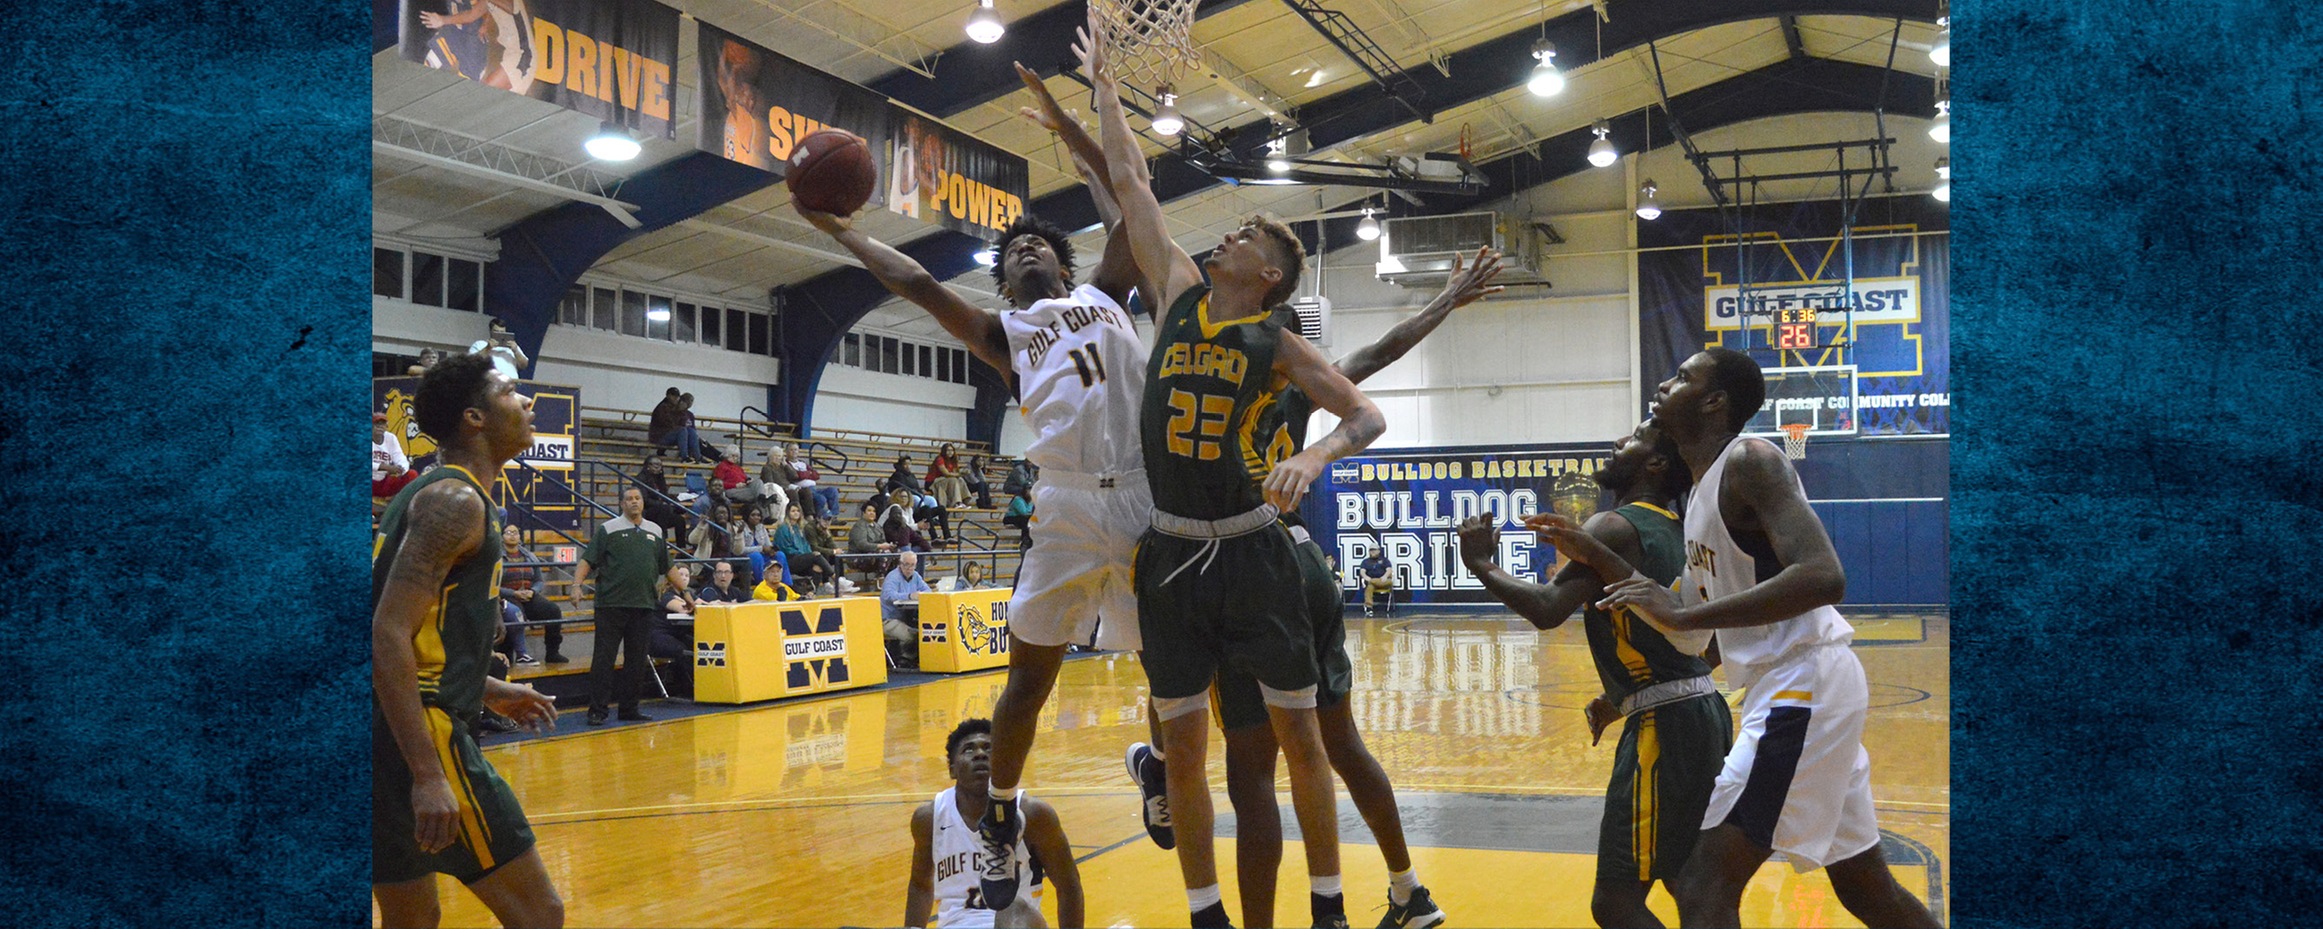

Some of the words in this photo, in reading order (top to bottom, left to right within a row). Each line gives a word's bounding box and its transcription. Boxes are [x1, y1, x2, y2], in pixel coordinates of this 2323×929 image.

[533, 16, 670, 121] DRIVE
[930, 169, 1024, 231] POWER
[1781, 309, 1816, 323] 6:36
[1027, 320, 1061, 367] GULF
[1061, 305, 1124, 334] COAST
[1780, 323, 1811, 348] 26
[1068, 341, 1107, 388] 11
[1158, 342, 1249, 391] DELGAD
[1827, 394, 1917, 409] COMUNITY
[1166, 387, 1236, 461] 23
[520, 442, 569, 459] OAST
[1361, 461, 1463, 481] BULLDOG
[1471, 458, 1606, 479] BASKETBAL
[1336, 488, 1538, 530] BULLDOG
[785, 642, 810, 656] GULF
[813, 638, 844, 654] COAST
[988, 626, 1011, 655] BU
[937, 852, 966, 882] GULF
